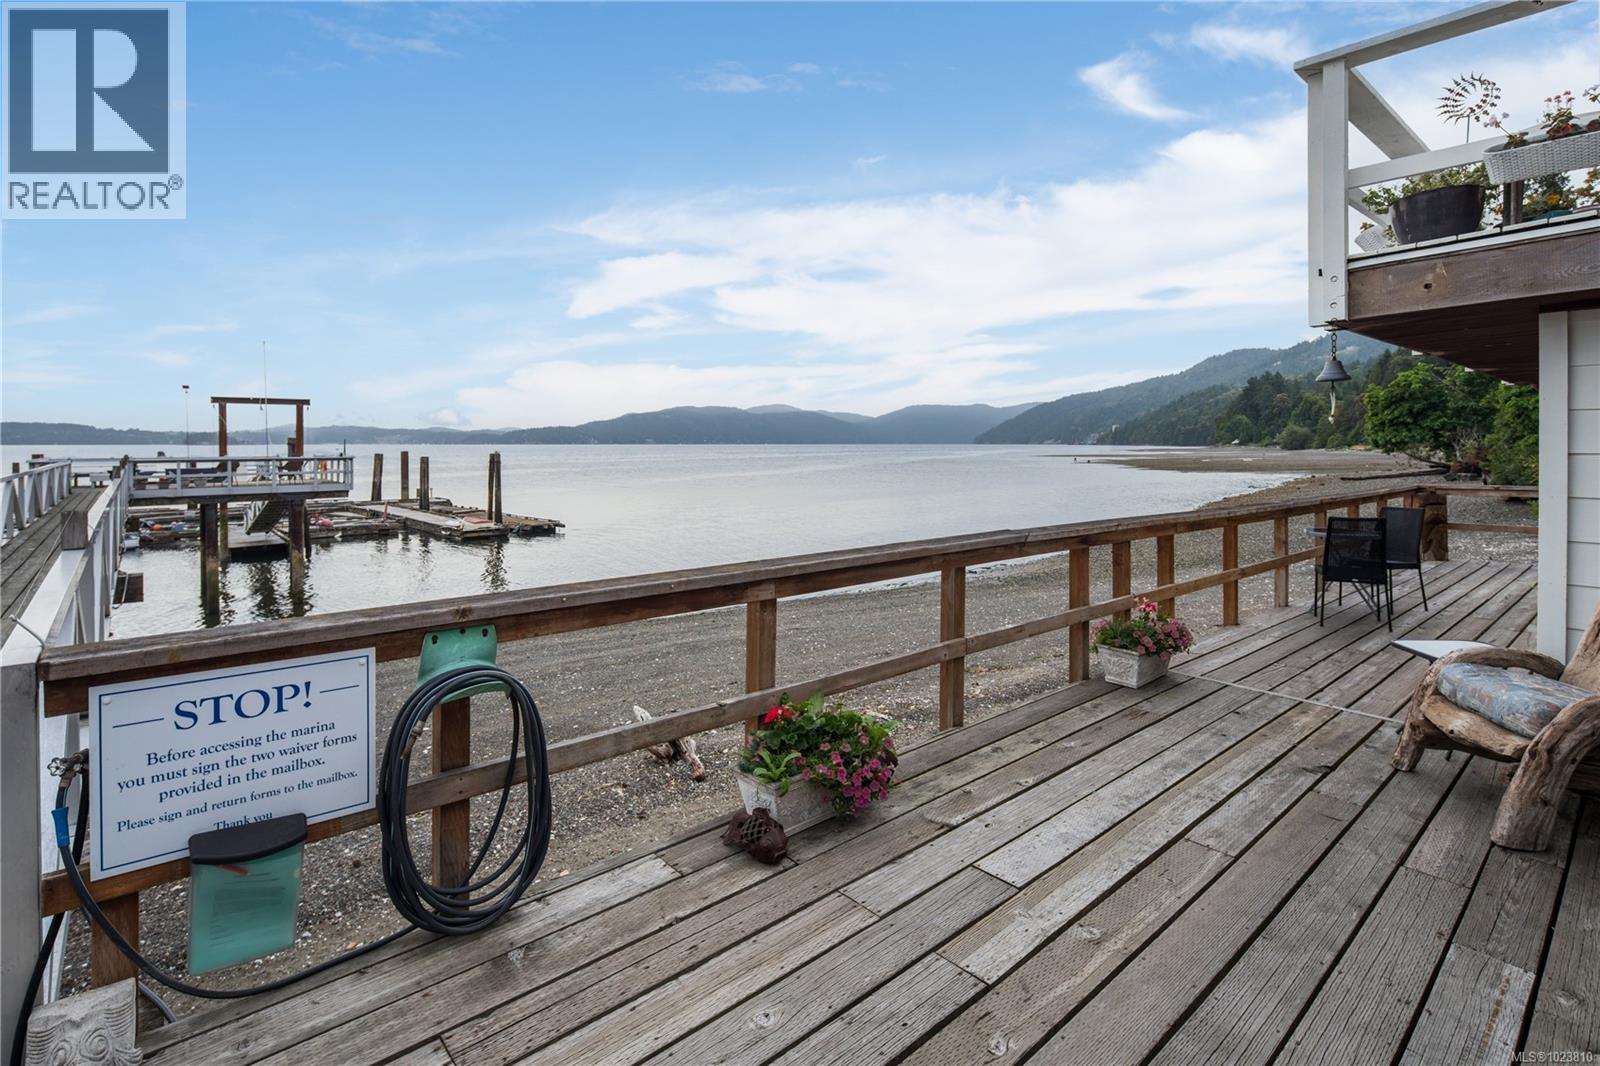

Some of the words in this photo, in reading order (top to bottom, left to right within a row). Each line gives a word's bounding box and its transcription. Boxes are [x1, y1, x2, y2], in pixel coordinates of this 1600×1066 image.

[174, 681, 311, 730] STOP!
[117, 776, 145, 792] you
[151, 769, 187, 784] must
[192, 761, 220, 778] sign
[225, 755, 247, 768] the
[251, 751, 275, 764] two
[279, 741, 319, 757] waiver
[323, 733, 357, 749] forms
[147, 749, 196, 766] Before
[200, 736, 262, 756] accessing
[266, 729, 287, 743] the
[291, 720, 336, 738] marina
[117, 817, 155, 832] Please
[158, 810, 183, 824] sign
[186, 803, 207, 817] and
[212, 796, 247, 810] return
[250, 787, 281, 801] forms
[285, 784, 295, 794] to
[298, 780, 314, 790] the
[317, 770, 357, 787] mailbox.
[159, 776, 222, 802] provided
[227, 774, 241, 785] in
[246, 768, 267, 782] the
[271, 758, 325, 776] mailbox.
[213, 817, 250, 831] Thank
